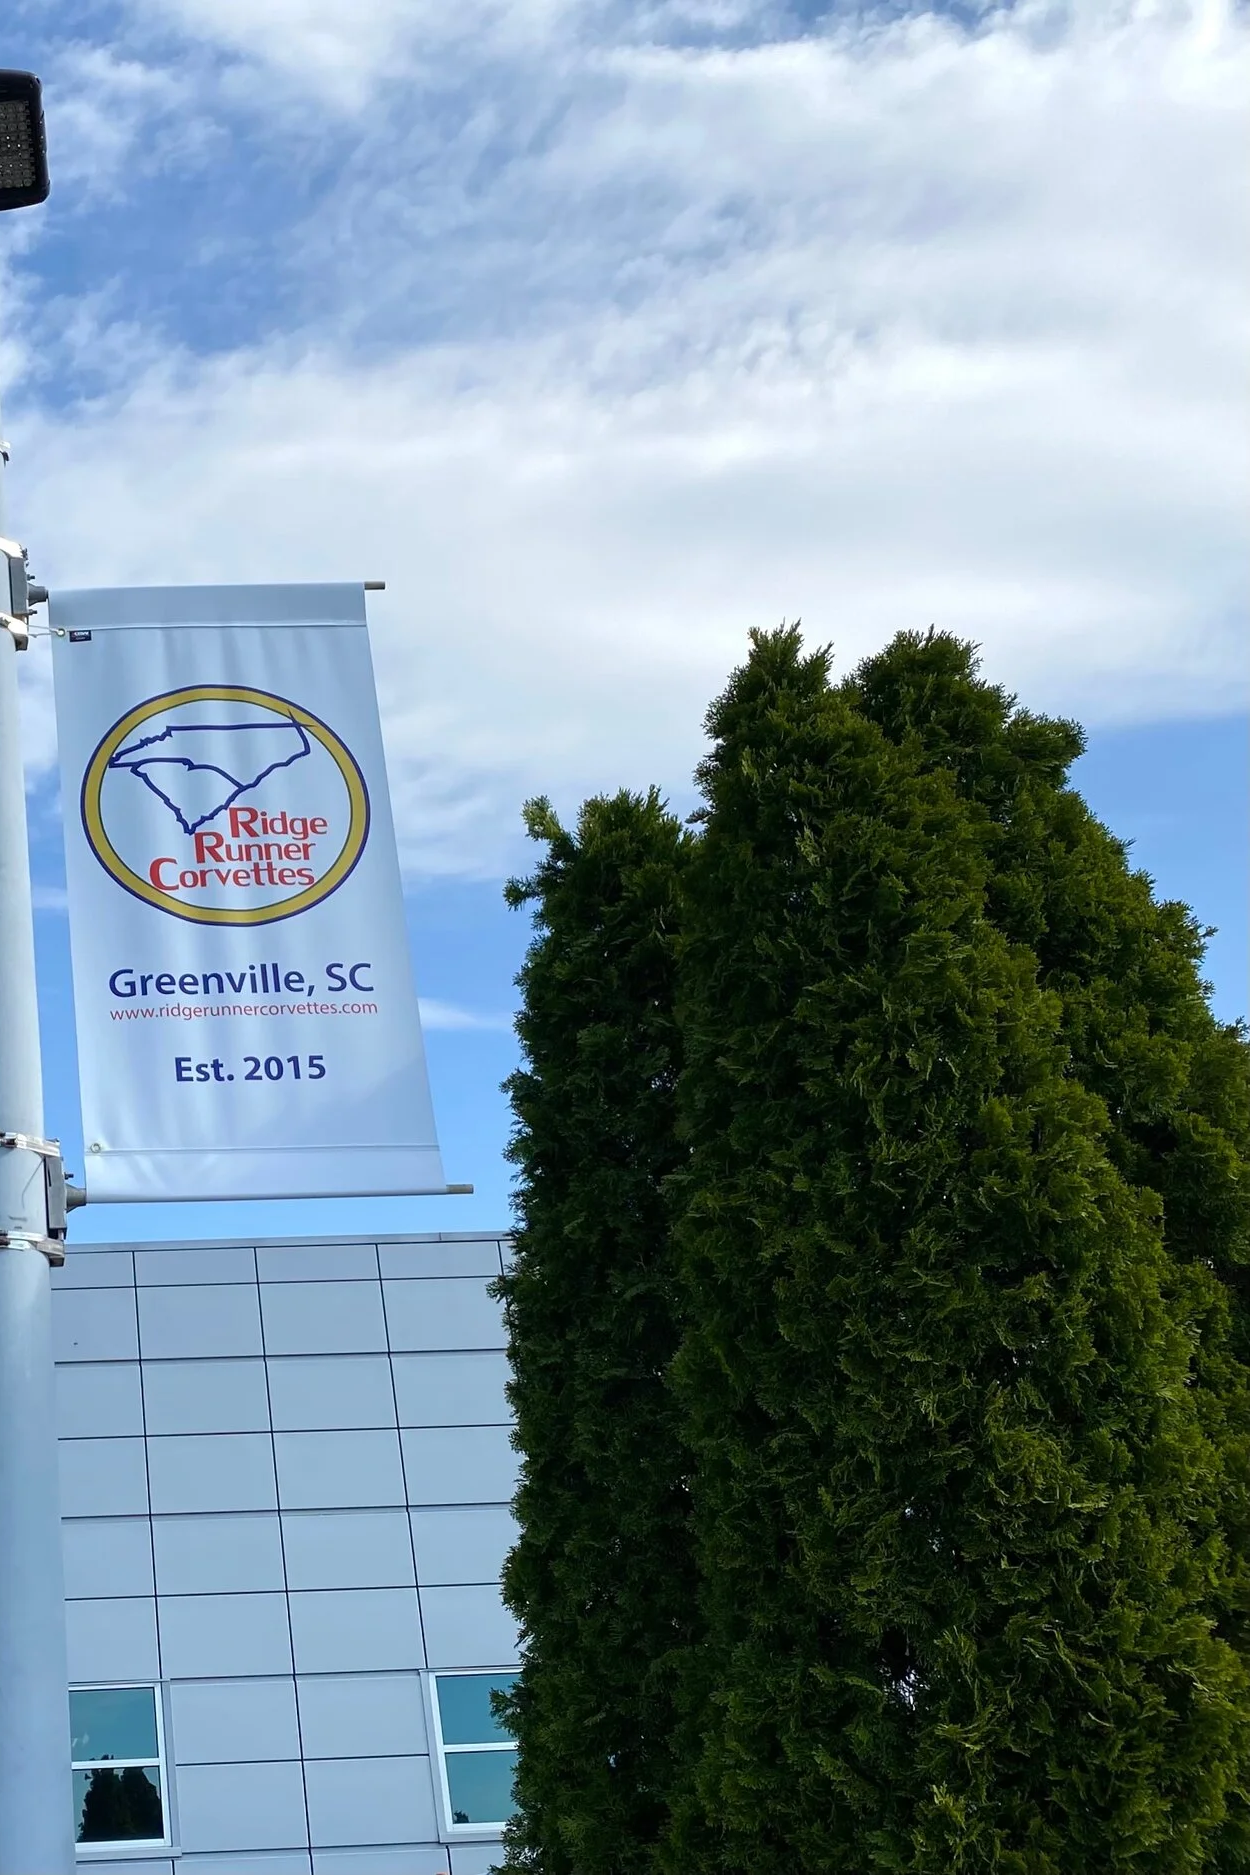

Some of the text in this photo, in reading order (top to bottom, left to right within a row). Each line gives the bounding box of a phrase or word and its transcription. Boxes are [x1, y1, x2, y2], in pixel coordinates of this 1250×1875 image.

[228, 807, 327, 840] Ridge
[194, 831, 316, 864] Runner
[149, 857, 315, 890] Corvettes
[109, 962, 374, 997] Greenville, SC
[110, 1001, 378, 1021] www.ridgerunnercorvettes.com
[175, 1055, 326, 1082] Est. 2015
